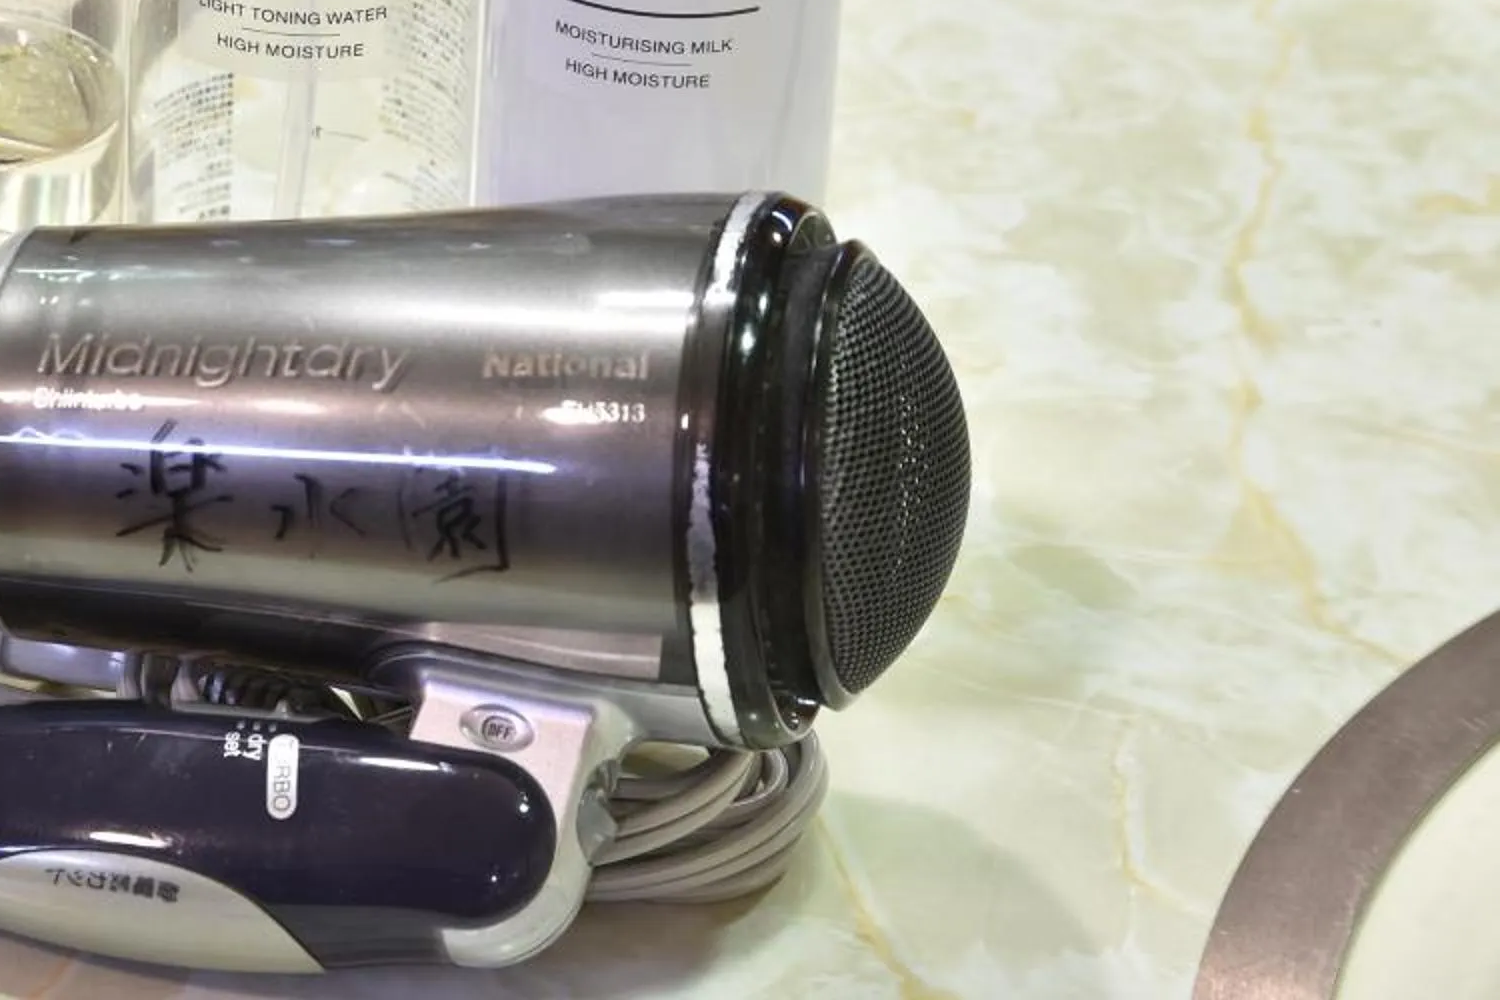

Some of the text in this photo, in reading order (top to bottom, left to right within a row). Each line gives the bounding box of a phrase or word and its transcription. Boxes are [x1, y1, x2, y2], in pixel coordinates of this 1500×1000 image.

[251, 6, 322, 27] TONING
[325, 5, 389, 26] WATER
[216, 32, 366, 60] HIGH MOISTURE
[555, 19, 734, 56] MOISTURISING MILK
[565, 58, 712, 90] HIGH MOISTURE
[36, 332, 409, 390] Midnightdry
[482, 348, 649, 380] National
[223, 731, 241, 757] set
[487, 722, 515, 740] OFF
[242, 733, 267, 760] dry
